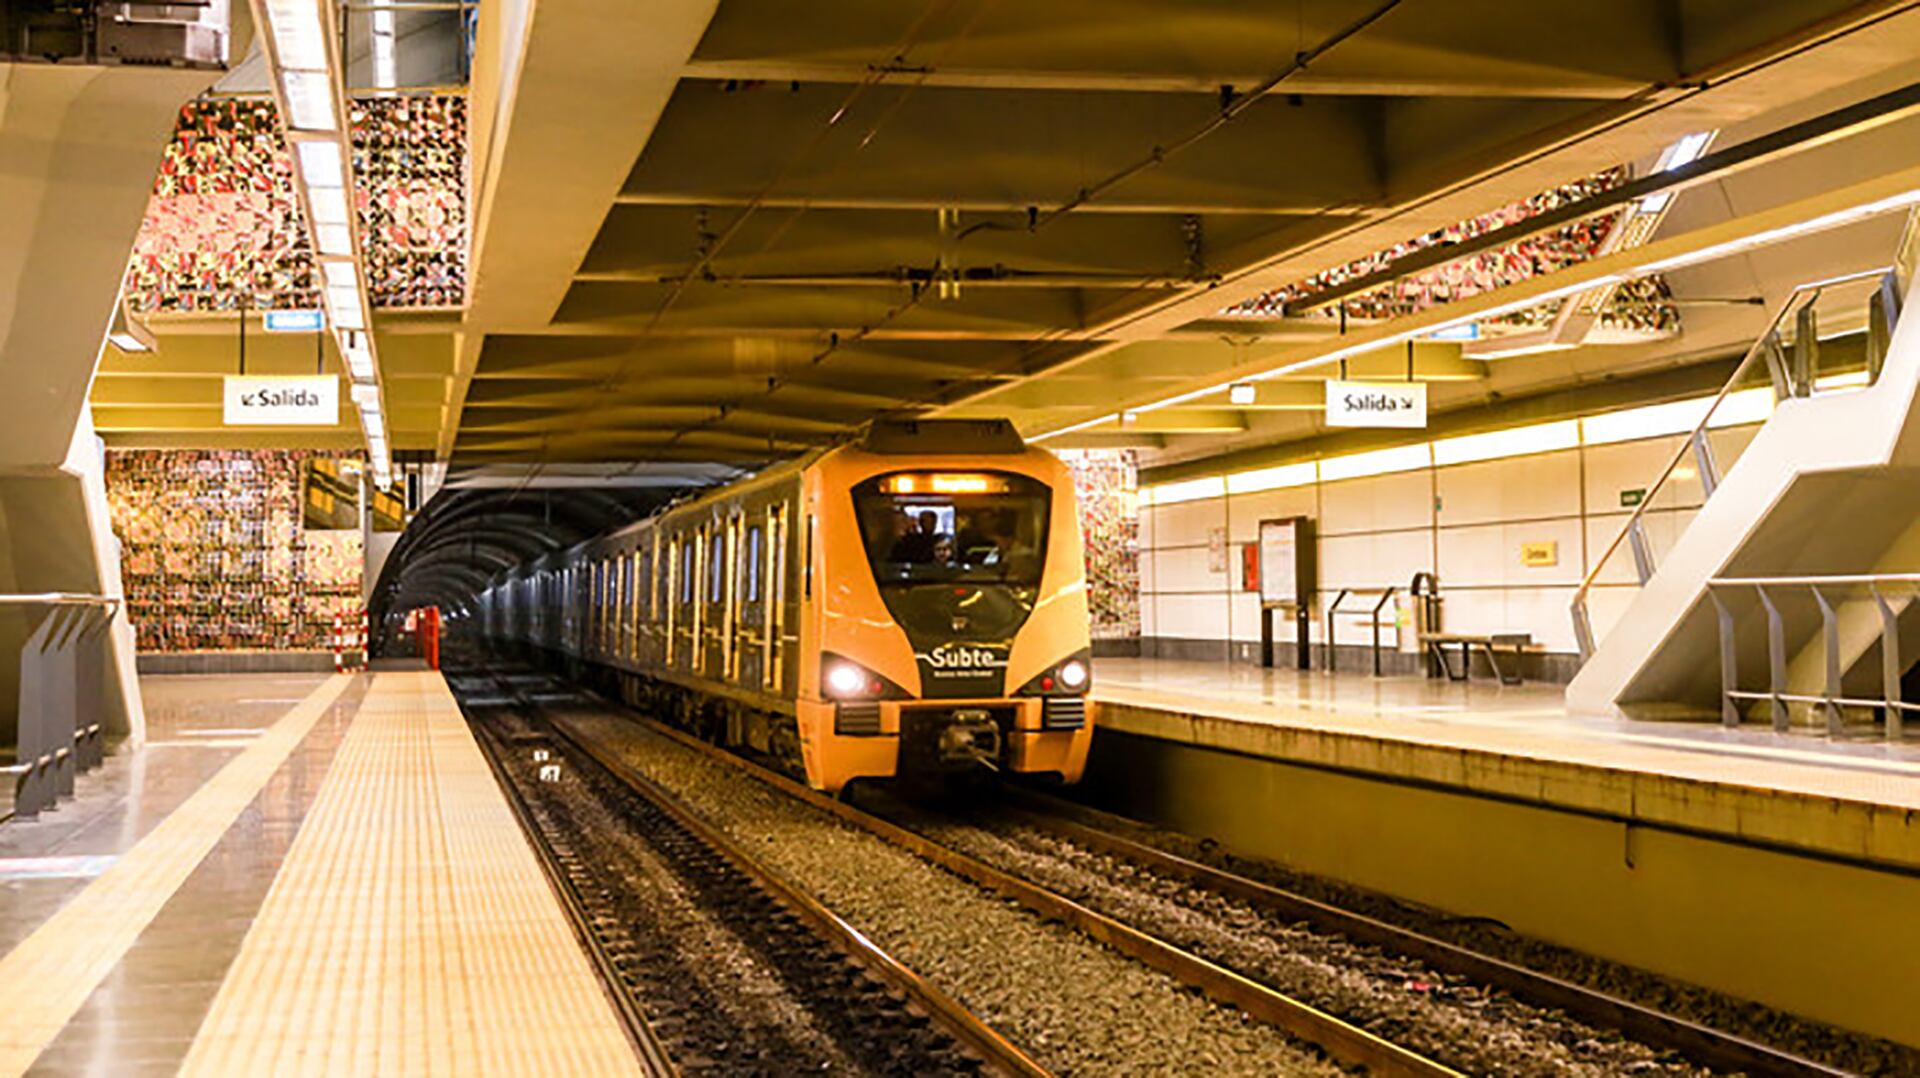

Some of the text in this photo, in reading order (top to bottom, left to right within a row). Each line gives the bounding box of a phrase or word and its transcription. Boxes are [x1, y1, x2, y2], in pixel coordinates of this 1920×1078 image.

[258, 388, 319, 406] Salida
[1343, 393, 1397, 412] Salida
[932, 647, 995, 668] Subte
